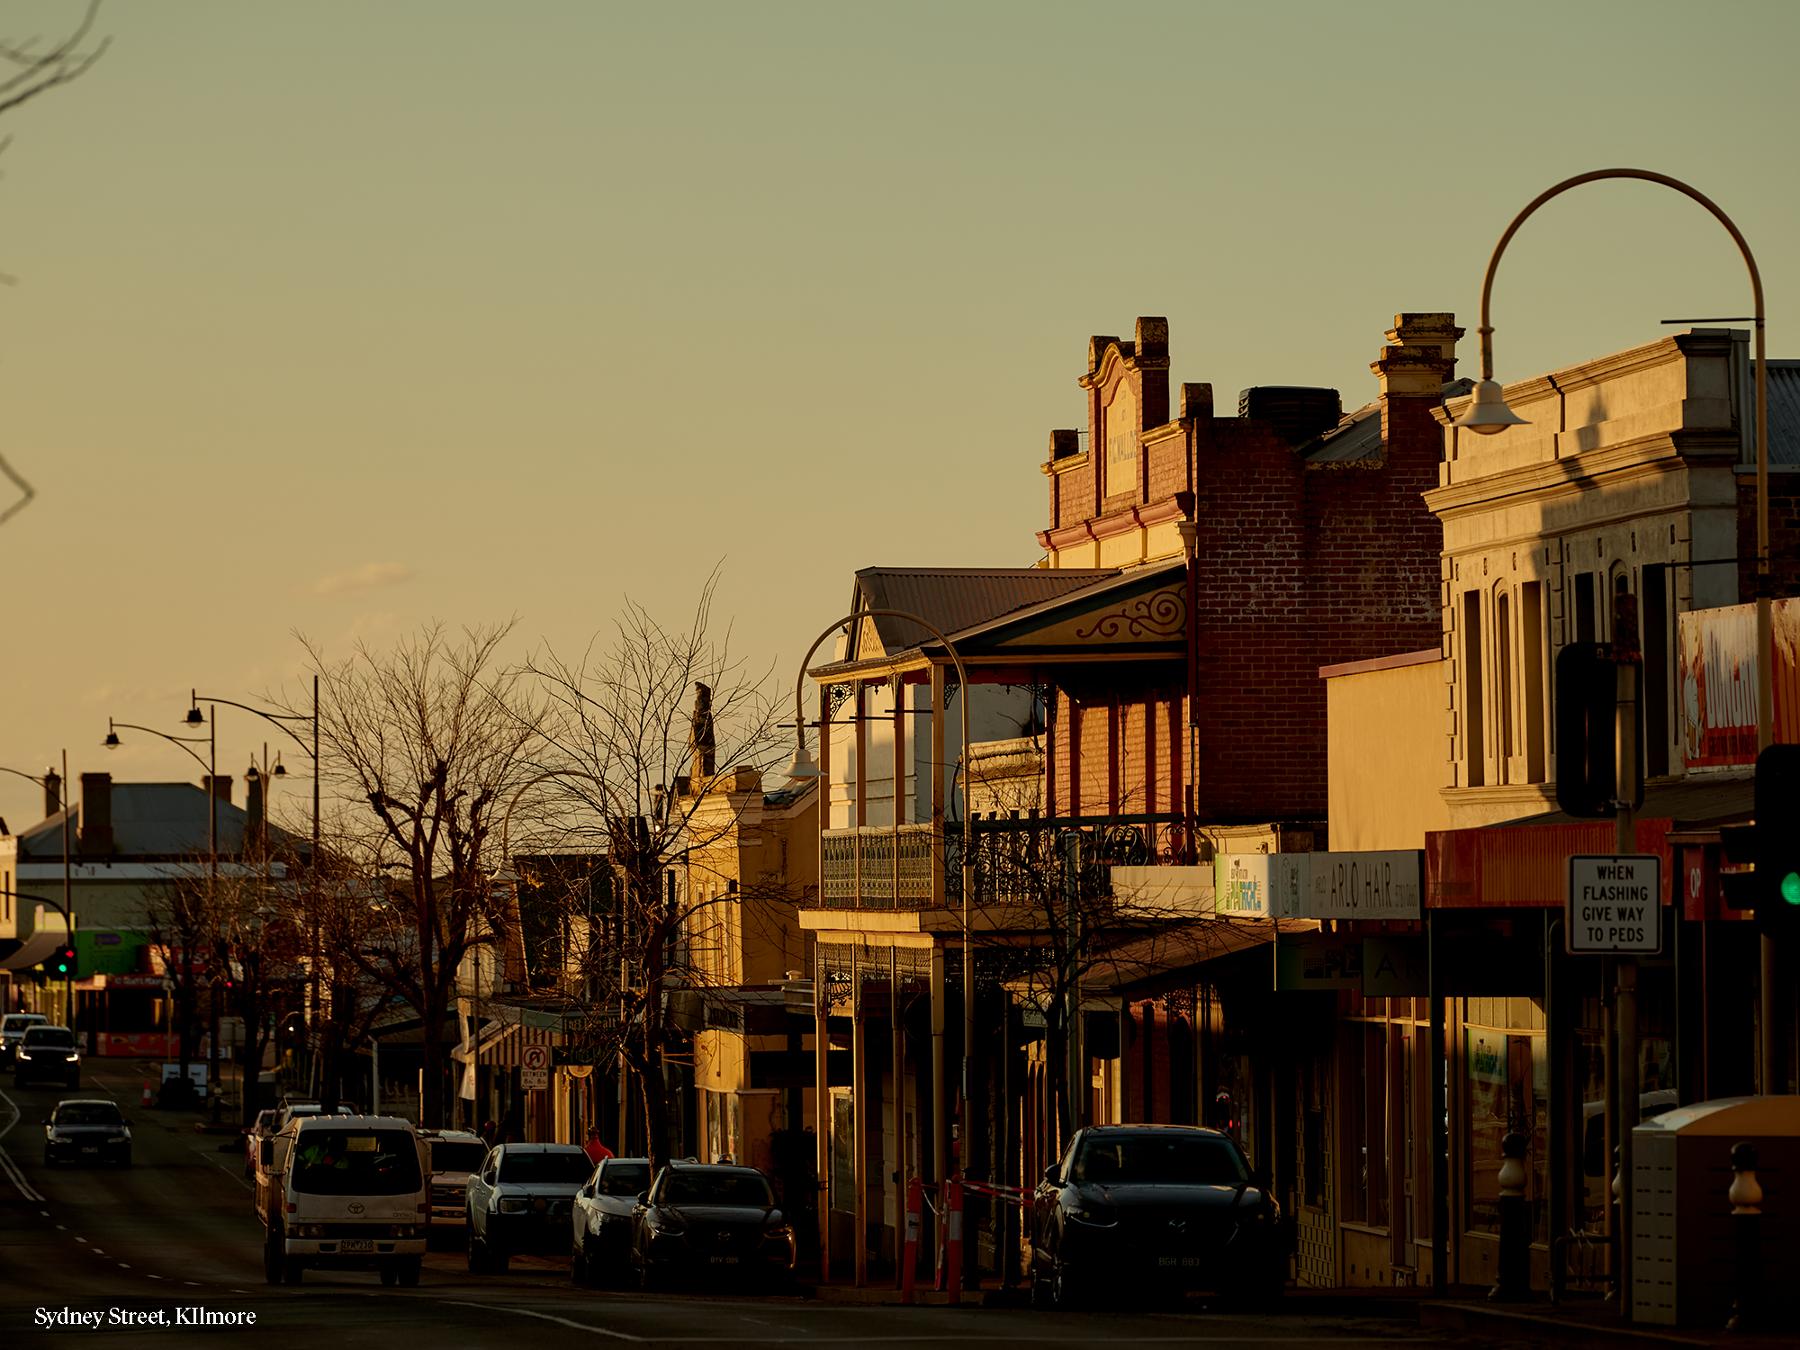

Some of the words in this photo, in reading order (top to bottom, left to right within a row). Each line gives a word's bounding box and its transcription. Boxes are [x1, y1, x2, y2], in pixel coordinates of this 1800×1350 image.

[1597, 865, 1634, 880] WHEN
[1330, 861, 1359, 908] ARLO
[1364, 861, 1392, 908] HAIR
[1583, 886, 1648, 901] FLASHING
[1582, 906, 1612, 921] GIVE
[1617, 906, 1644, 921] WAY
[1587, 927, 1604, 942] TO
[1609, 927, 1644, 942] PEDS
